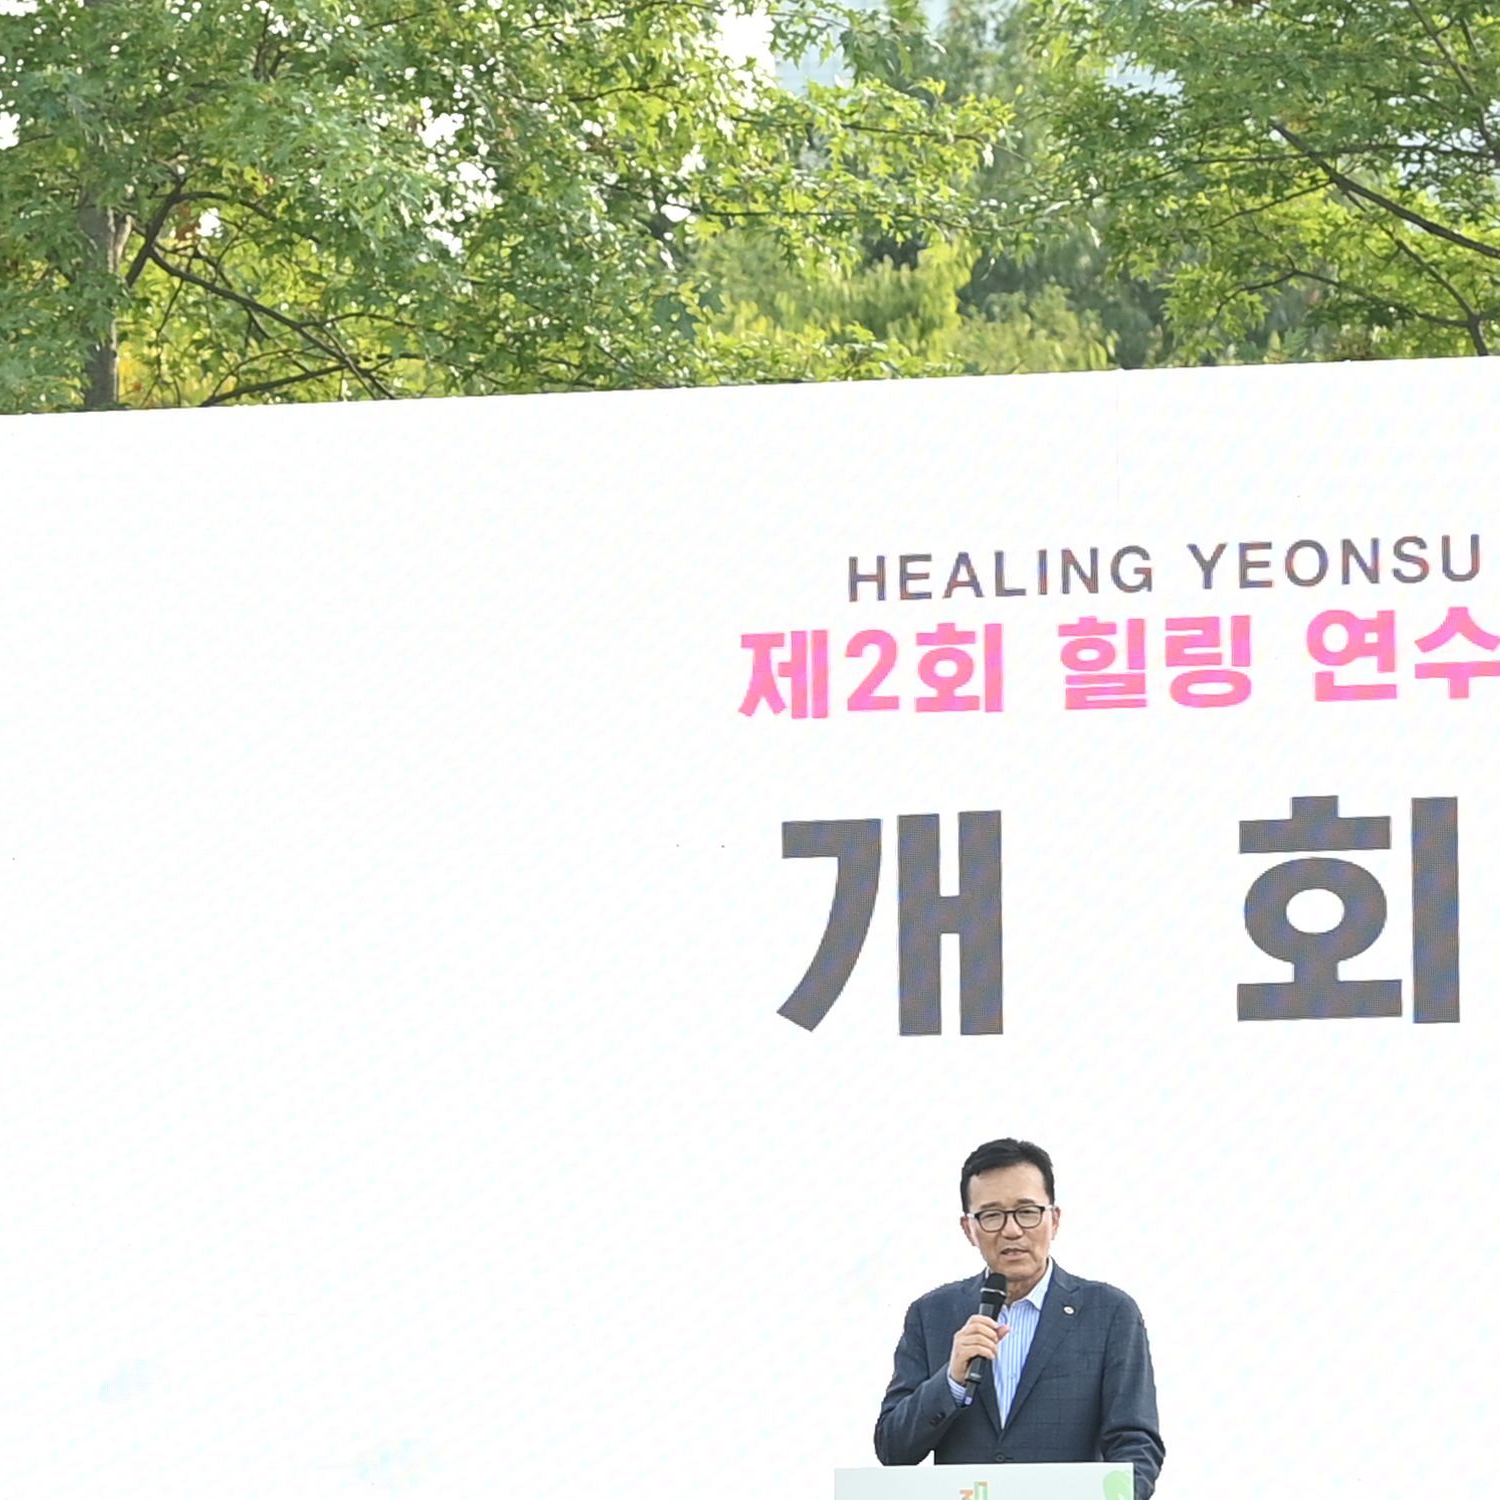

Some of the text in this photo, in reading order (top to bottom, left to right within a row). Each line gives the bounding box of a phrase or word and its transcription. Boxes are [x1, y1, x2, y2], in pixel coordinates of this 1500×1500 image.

[848, 545, 1153, 603] HEALING
[1186, 534, 1480, 590] YEONSU
[738, 622, 1004, 720] 제2회
[1057, 614, 1252, 711] 힐링
